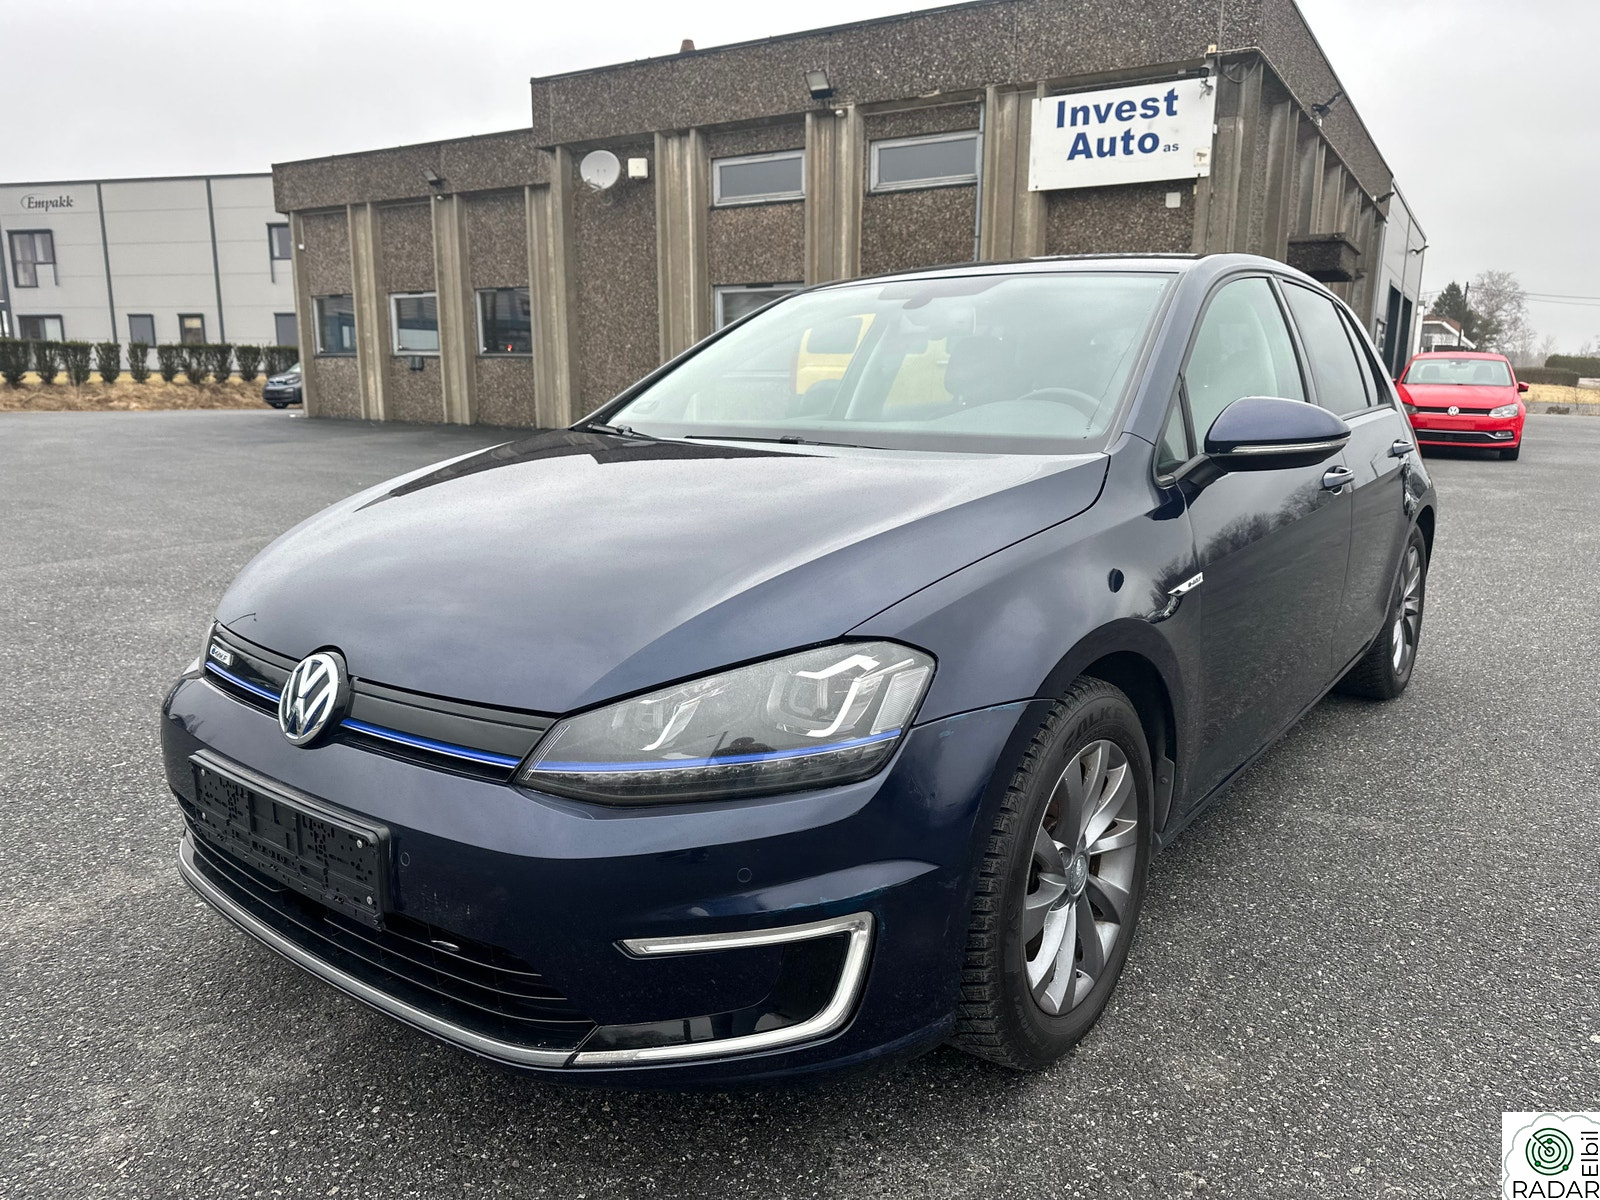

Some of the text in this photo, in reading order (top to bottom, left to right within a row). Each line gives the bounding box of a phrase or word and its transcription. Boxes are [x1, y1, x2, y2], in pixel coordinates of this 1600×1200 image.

[1056, 87, 1179, 129] Invest
[1067, 127, 1179, 161] Auto as
[27, 195, 74, 213] Empakk
